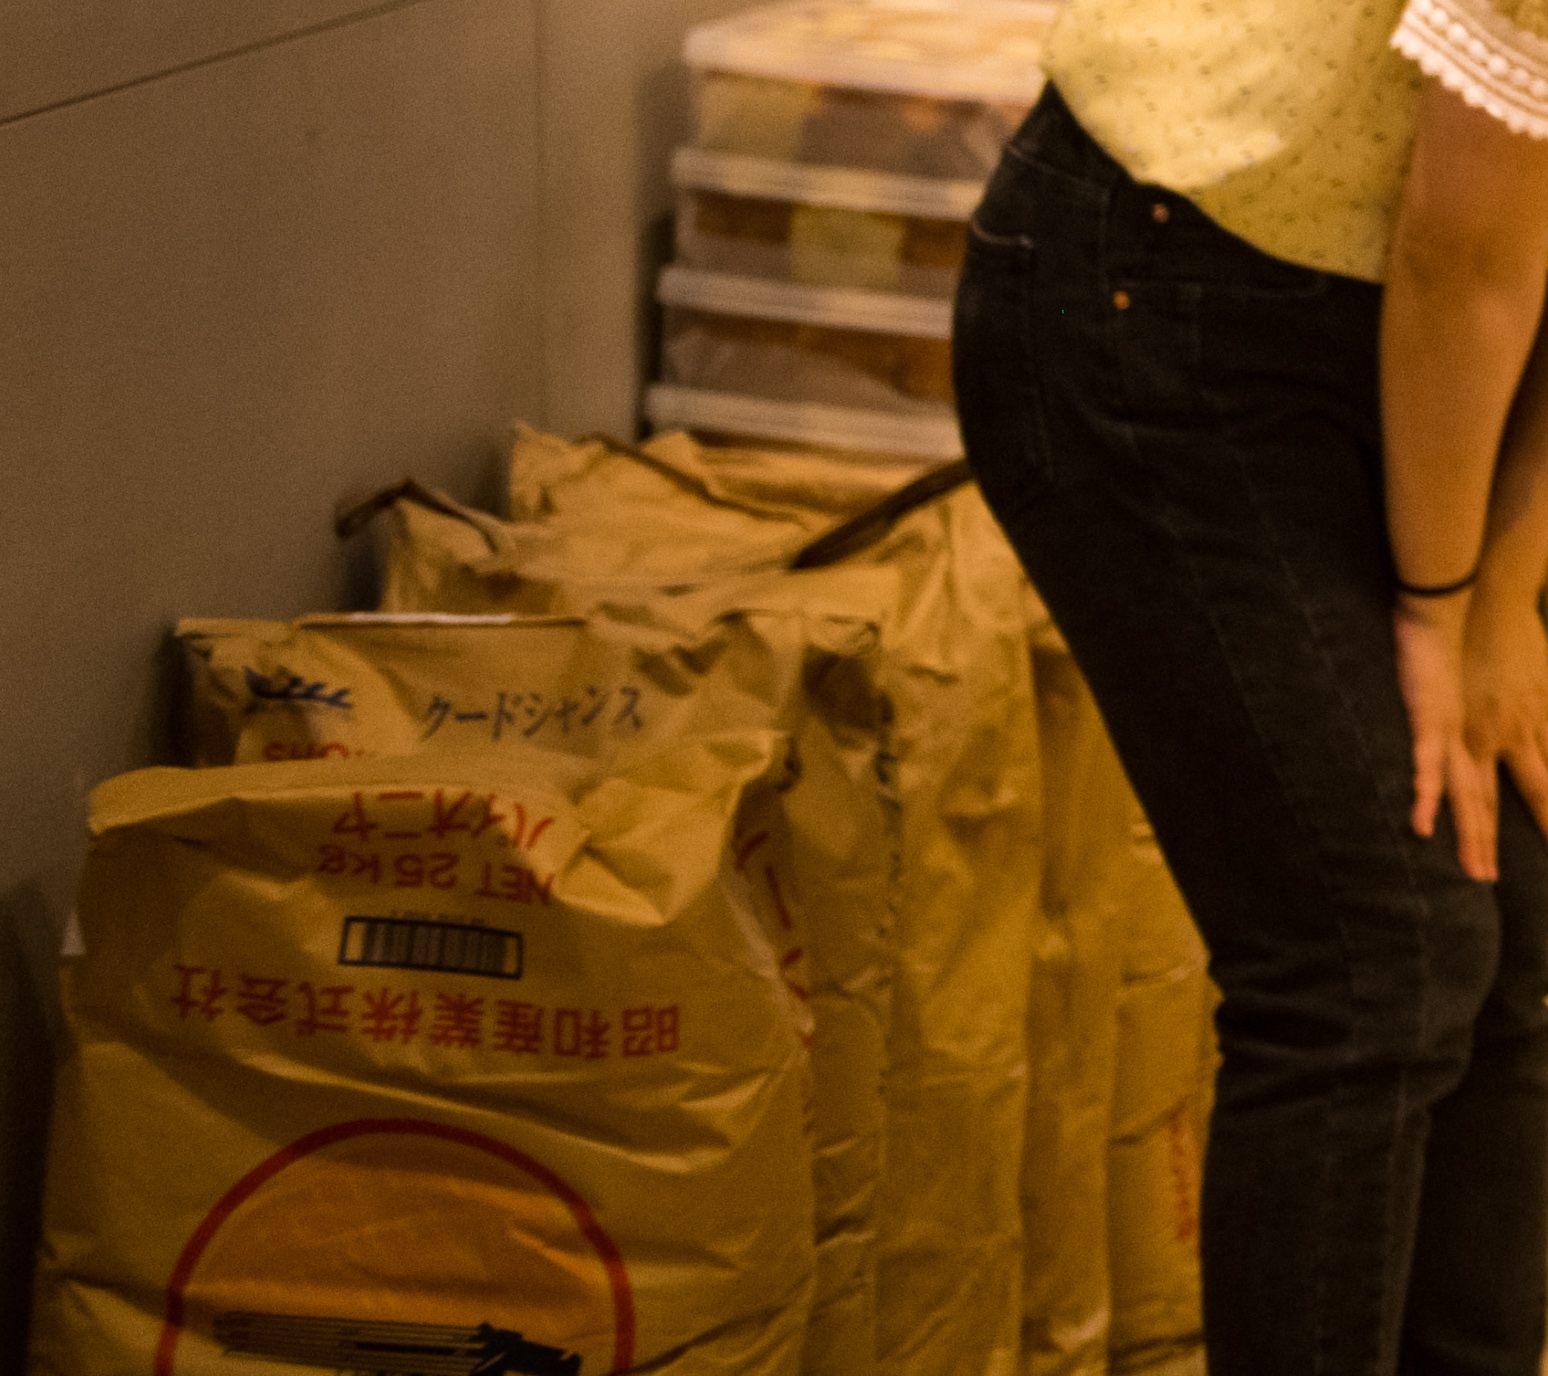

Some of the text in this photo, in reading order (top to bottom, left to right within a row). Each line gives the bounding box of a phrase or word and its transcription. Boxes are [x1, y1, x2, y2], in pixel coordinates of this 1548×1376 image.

[421, 686, 645, 740] クードシャンス
[317, 844, 552, 908] NET 25 kg
[170, 963, 682, 1061] 昭和産業株式会社
